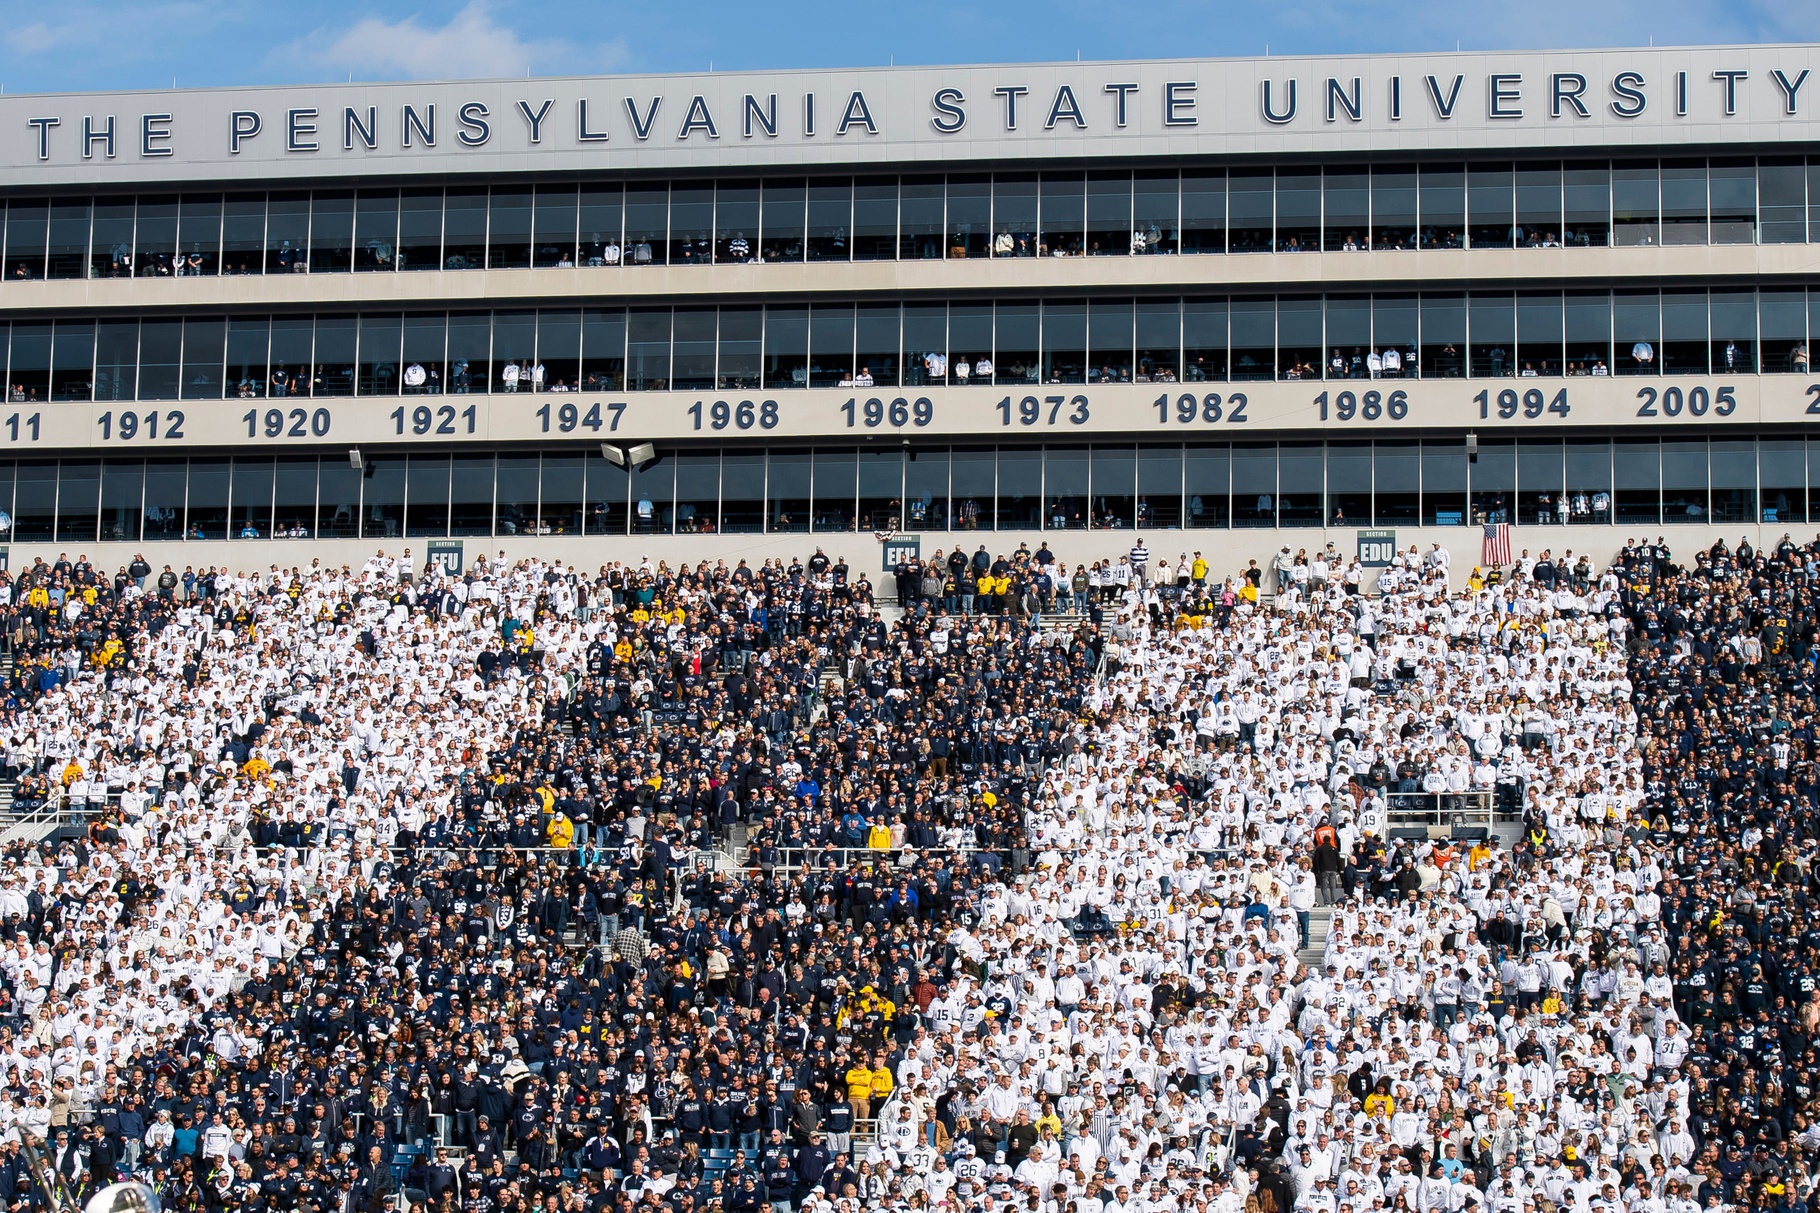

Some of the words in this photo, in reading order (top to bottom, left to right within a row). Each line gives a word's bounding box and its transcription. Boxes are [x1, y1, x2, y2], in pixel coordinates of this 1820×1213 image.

[28, 112, 174, 161] THE
[229, 90, 880, 155] PENNSYLVANIA
[931, 80, 1199, 134] STATE
[1261, 68, 1813, 124] UNIVERSITY
[1406, 353, 1416, 361] 26
[98, 410, 186, 440] 1912
[243, 407, 332, 439] 1920
[390, 404, 478, 437] 1921
[536, 402, 627, 435] 1947
[688, 399, 780, 432] 1968
[841, 396, 934, 429] 1969
[996, 394, 1090, 427] 1973
[1153, 392, 1249, 424] 1982
[1313, 389, 1409, 422] 1986
[1473, 386, 1571, 419] 1994
[1637, 384, 1737, 417] 2005
[1360, 543, 1392, 562] EDU
[1641, 548, 1651, 556] 10
[1102, 570, 1111, 578] 26
[1118, 569, 1125, 578] 11
[1714, 569, 1724, 577] 26
[1383, 578, 1392, 586] 15
[1784, 575, 1788, 583] 1
[792, 605, 801, 614] 31
[1777, 619, 1787, 627] 33
[1418, 641, 1424, 649] 9
[1270, 652, 1280, 660] 22
[1382, 664, 1388, 672] 5
[1518, 660, 1522, 668] 1
[15, 669, 21, 678] 2
[1257, 697, 1260, 705] 1
[1562, 711, 1573, 720] 31
[1511, 753, 1515, 761] 1
[1778, 751, 1785, 759] 11
[785, 768, 798, 777] 26
[544, 791, 548, 799] 1
[455, 799, 462, 808] 2
[1616, 800, 1622, 808] 2
[1364, 815, 1376, 826] 19
[1556, 819, 1560, 827] 1
[304, 825, 311, 834] 9
[378, 823, 390, 834] 34
[429, 828, 436, 838] 6
[454, 825, 465, 835] 17
[207, 848, 214, 859] 26
[620, 849, 631, 859] 58
[1642, 873, 1652, 883] 14
[120, 884, 128, 893] 2
[454, 903, 467, 914] 96
[1033, 905, 1042, 915] 16
[1150, 909, 1162, 919] 31
[1672, 913, 1678, 924] 1
[960, 913, 972, 925] 15
[147, 920, 158, 930] 26
[484, 979, 491, 990] 2
[1801, 979, 1815, 991] 26
[937, 1009, 948, 1020] 15
[968, 1013, 974, 1021] 2
[601, 1028, 607, 1041] 2
[1739, 1036, 1754, 1049] 32
[1663, 1043, 1675, 1053] 31
[1038, 1049, 1045, 1059] 8
[881, 1153, 886, 1161] 1
[914, 1154, 929, 1167] 33
[961, 1164, 977, 1177] 26
